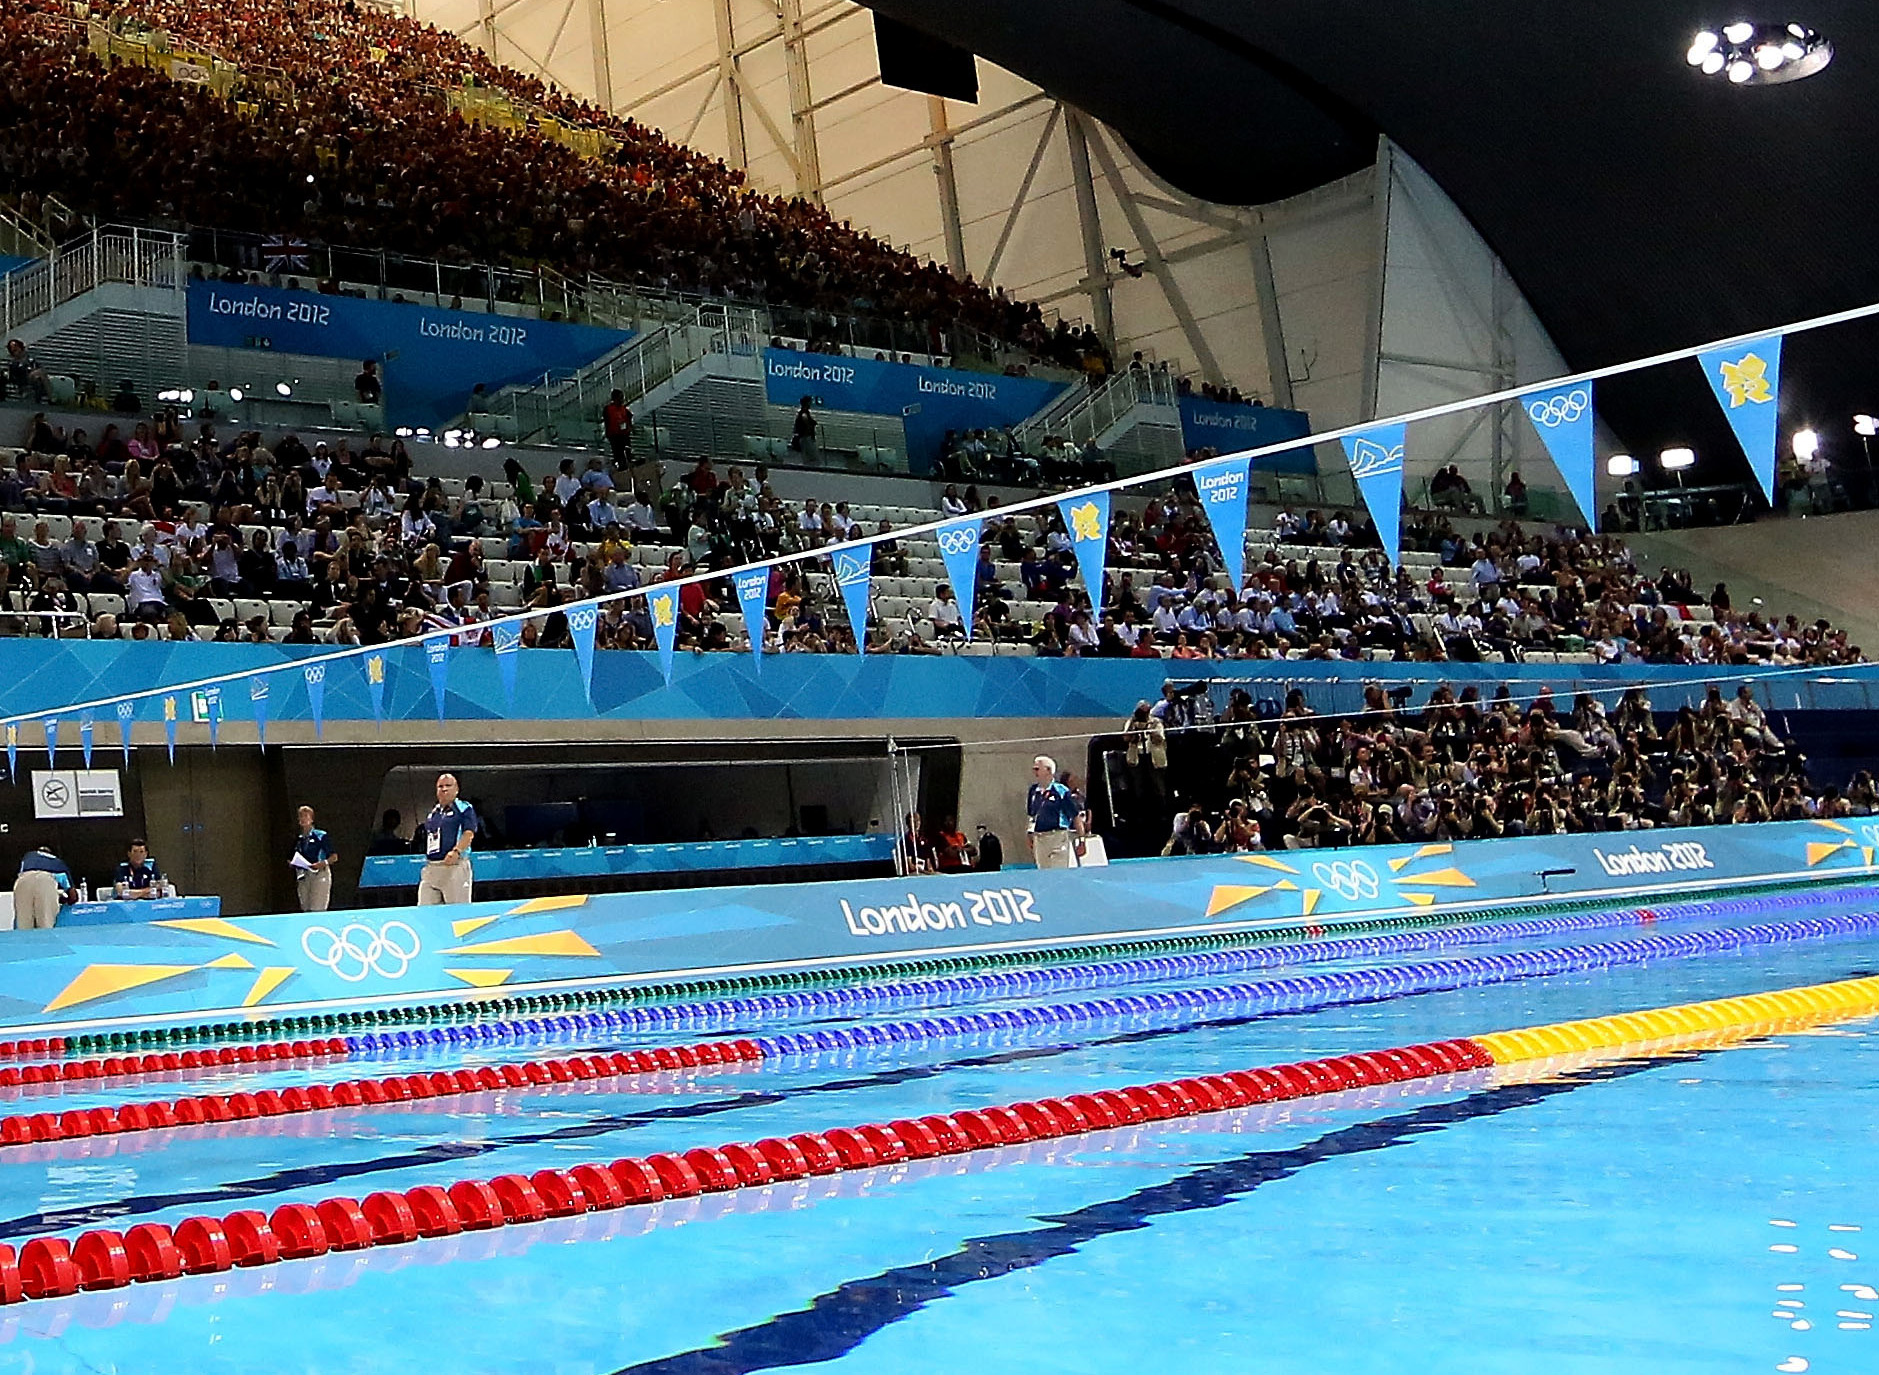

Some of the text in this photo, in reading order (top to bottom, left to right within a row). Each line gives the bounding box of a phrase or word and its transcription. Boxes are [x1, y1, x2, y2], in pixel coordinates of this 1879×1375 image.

[209, 292, 330, 326] London 2012
[420, 317, 526, 346] London 2012
[768, 358, 855, 384] London 2012
[918, 375, 998, 400] London 2012
[1193, 410, 1257, 432] London 2012
[1200, 470, 1244, 490] London
[1210, 486, 1238, 503] 2012
[737, 575, 766, 589] London
[743, 587, 762, 601] 2012
[1592, 840, 1715, 876] London 2012
[838, 887, 1041, 936] London 2012
